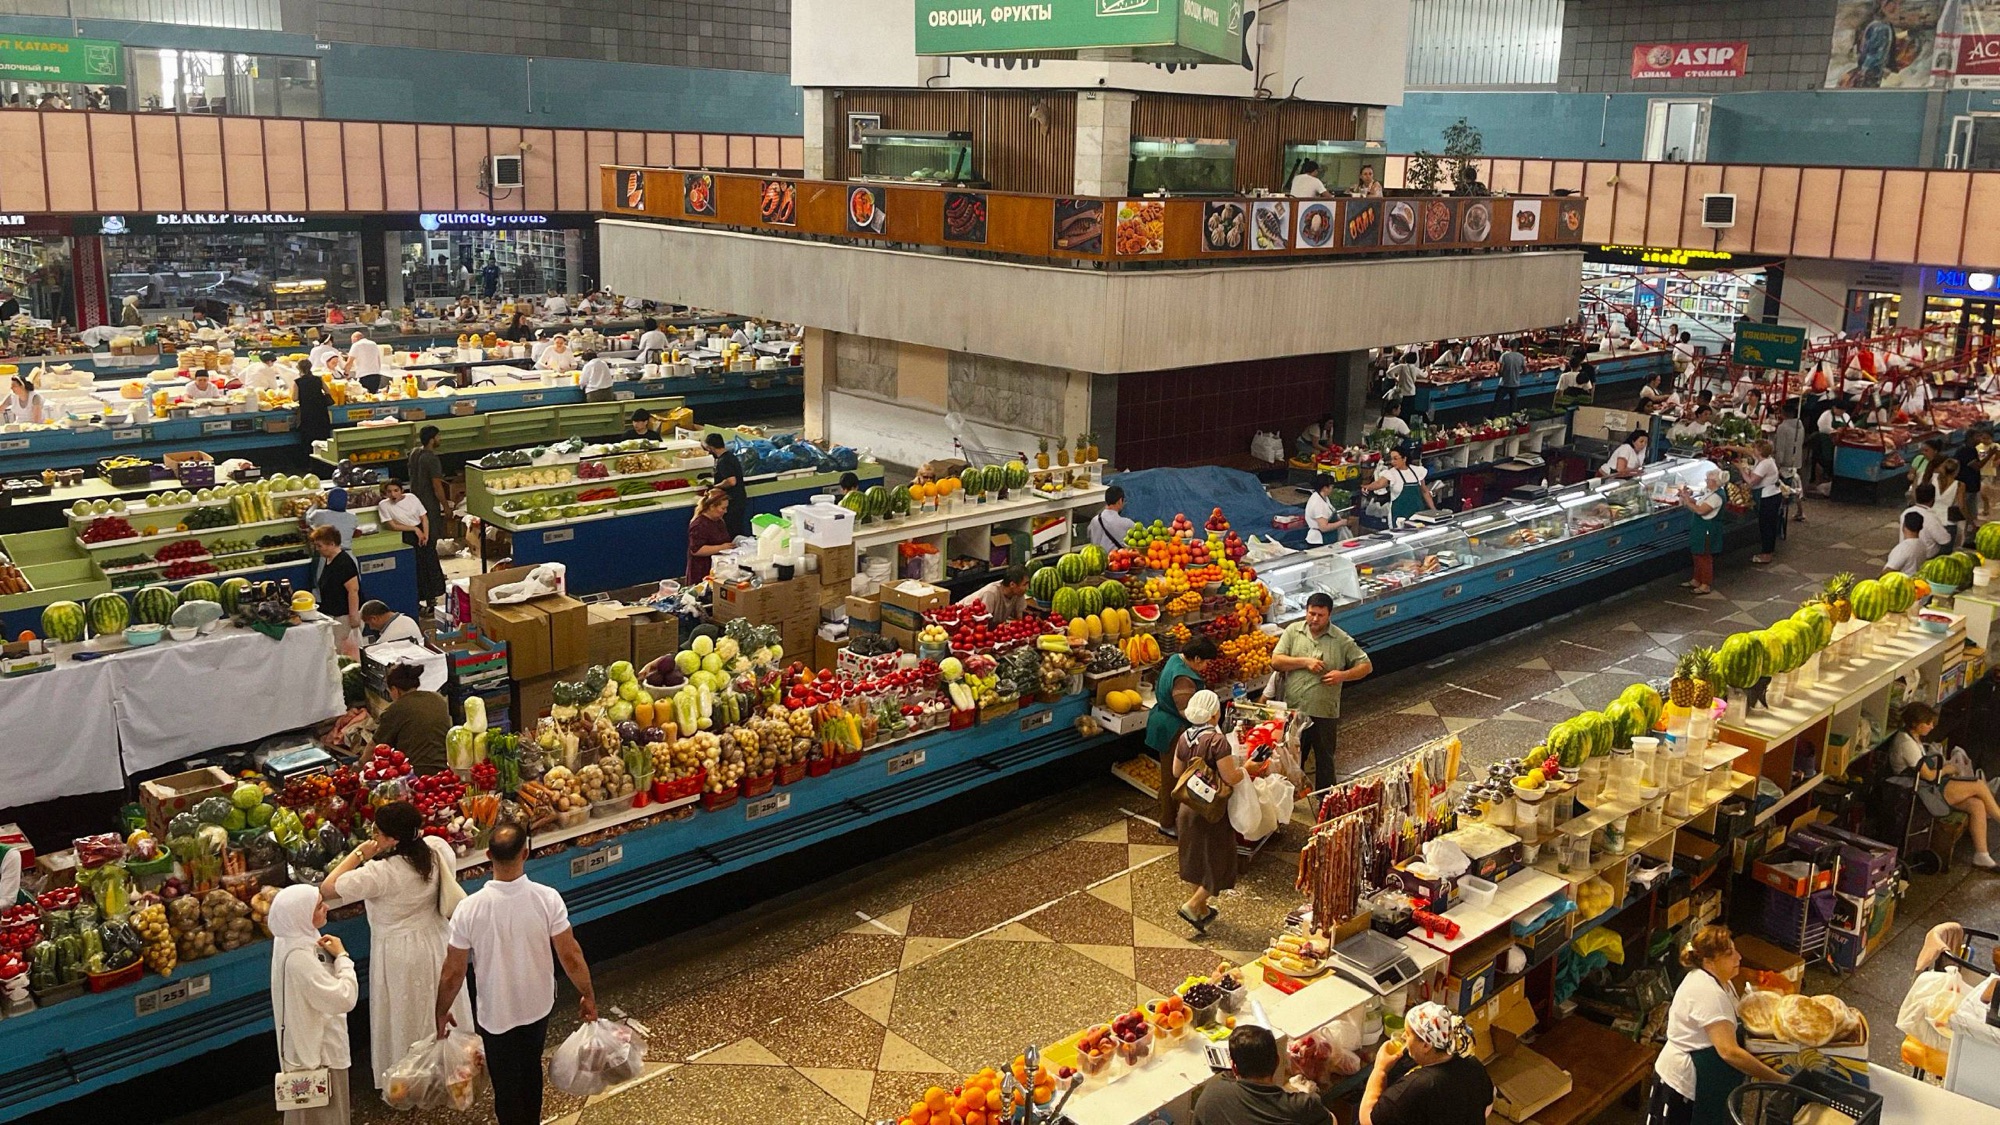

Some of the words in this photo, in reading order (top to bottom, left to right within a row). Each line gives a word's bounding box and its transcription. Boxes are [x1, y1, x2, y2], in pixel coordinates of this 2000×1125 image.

[928, 9, 986, 27] ОВОЩИ,
[991, 4, 1052, 23] ФРУКТЫ
[1674, 48, 1734, 65] ASIP
[44, 65, 61, 74] РЯД
[762, 802, 776, 812] 250
[590, 855, 605, 866] 251
[162, 989, 185, 1002] 253
